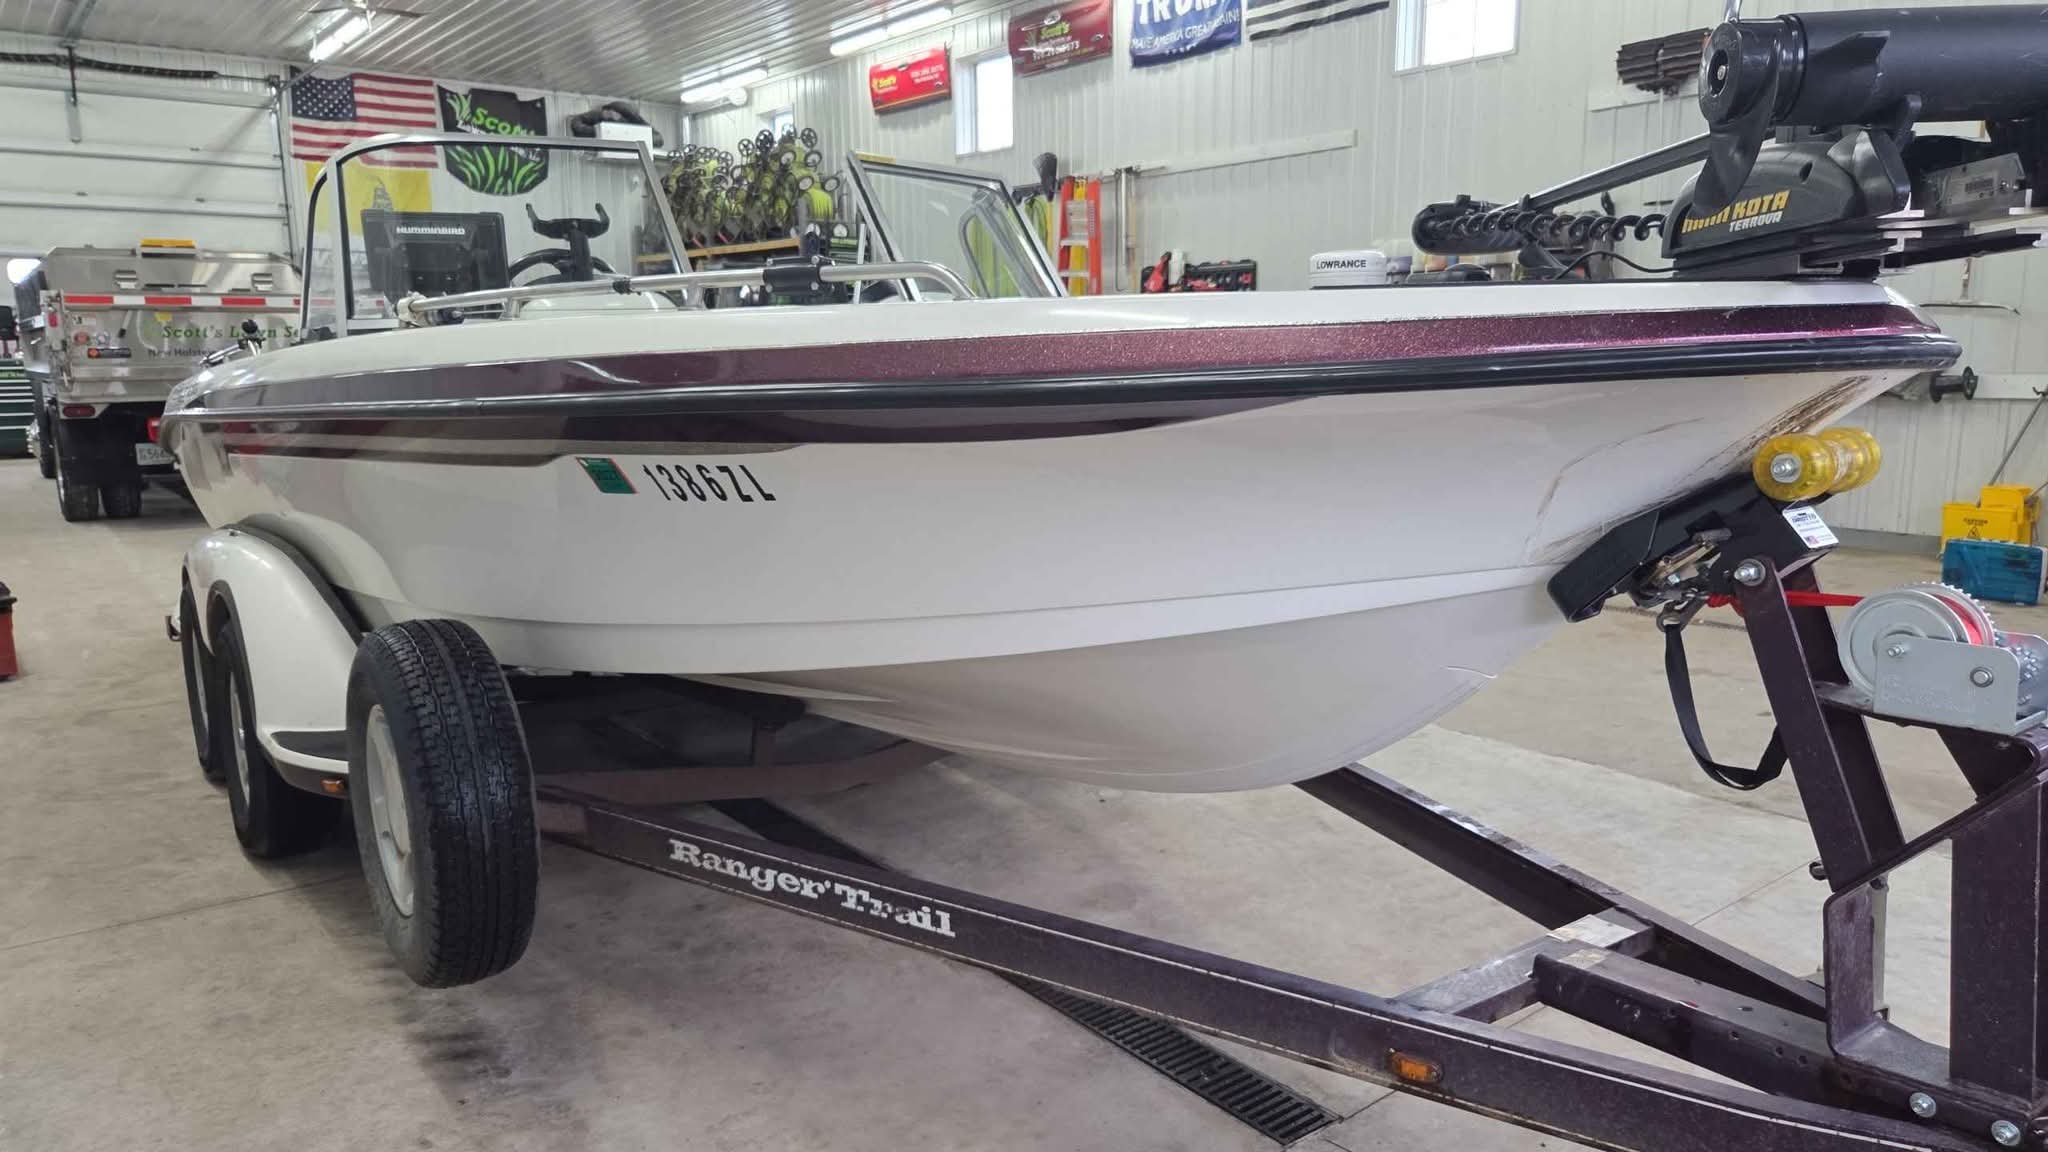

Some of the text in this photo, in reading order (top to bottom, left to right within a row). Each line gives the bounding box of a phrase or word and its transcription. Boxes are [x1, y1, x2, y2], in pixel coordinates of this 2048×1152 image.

[1732, 189, 1791, 220] KOTA
[1729, 211, 1783, 232] TERROVA
[1316, 259, 1367, 270] LOWRANCE
[162, 325, 223, 338] Scott's
[641, 464, 776, 502] 1386ZL
[669, 838, 956, 937] Ranger Trail
